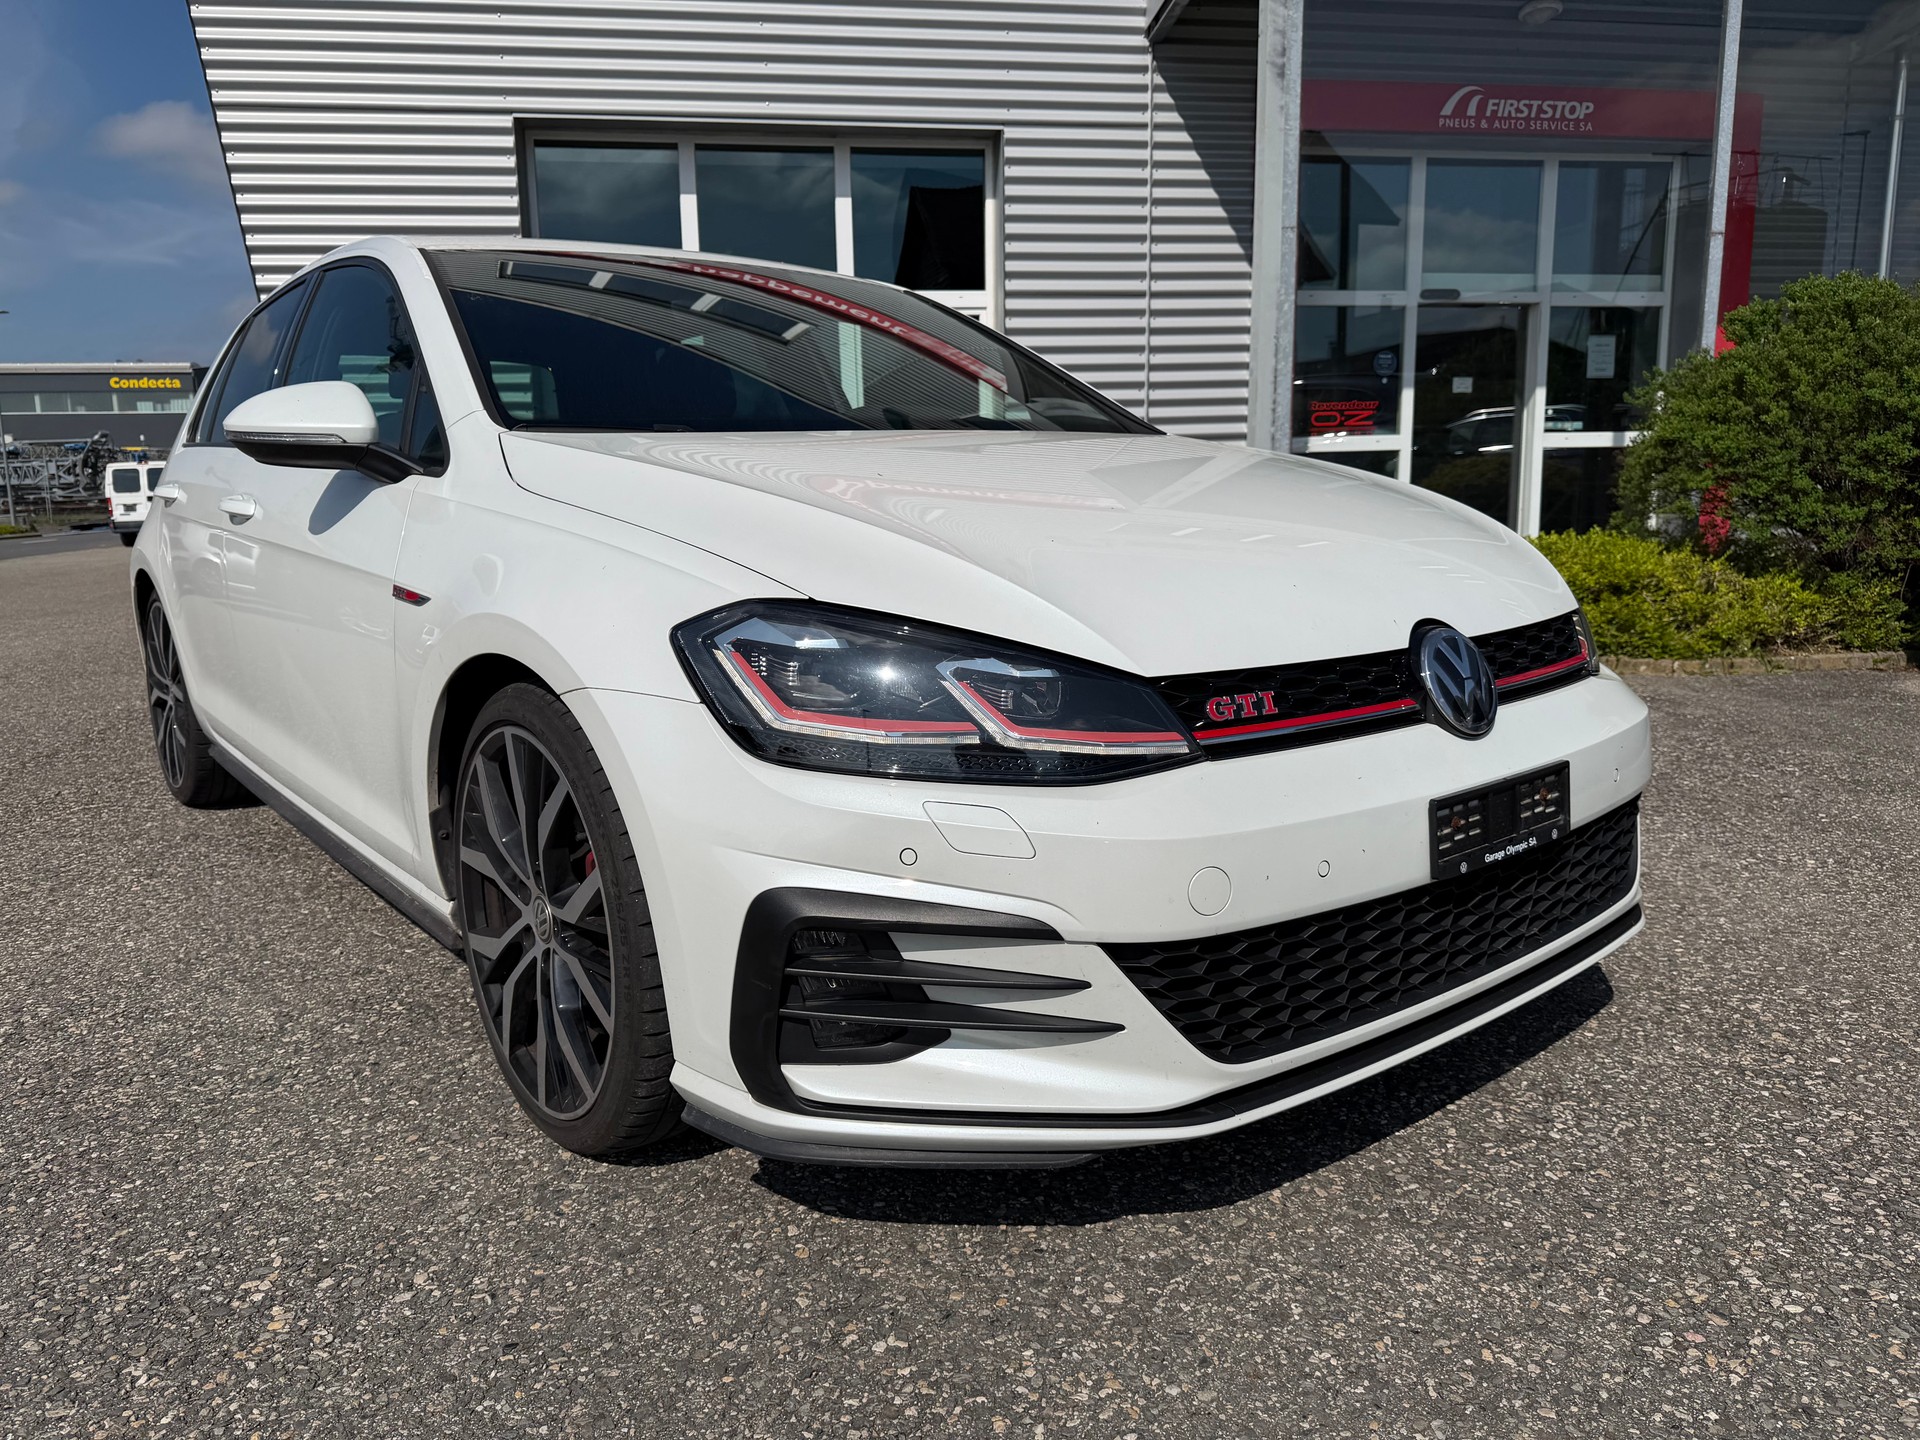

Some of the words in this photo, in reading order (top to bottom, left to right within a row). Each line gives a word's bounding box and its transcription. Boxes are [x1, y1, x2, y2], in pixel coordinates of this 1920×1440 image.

[1438, 118, 1476, 129] PNEUS
[1480, 119, 1489, 129] &
[1492, 119, 1526, 130] AUTO
[1529, 120, 1576, 131] SERVICE
[1579, 121, 1594, 132] SA
[109, 376, 182, 389] Condecta
[1206, 690, 1279, 722] GTI
[1484, 850, 1505, 863] Garage
[1505, 841, 1528, 855] Olympic
[1528, 836, 1538, 847] SA
[610, 876, 629, 947] 225/35
[621, 953, 631, 978] ZR
